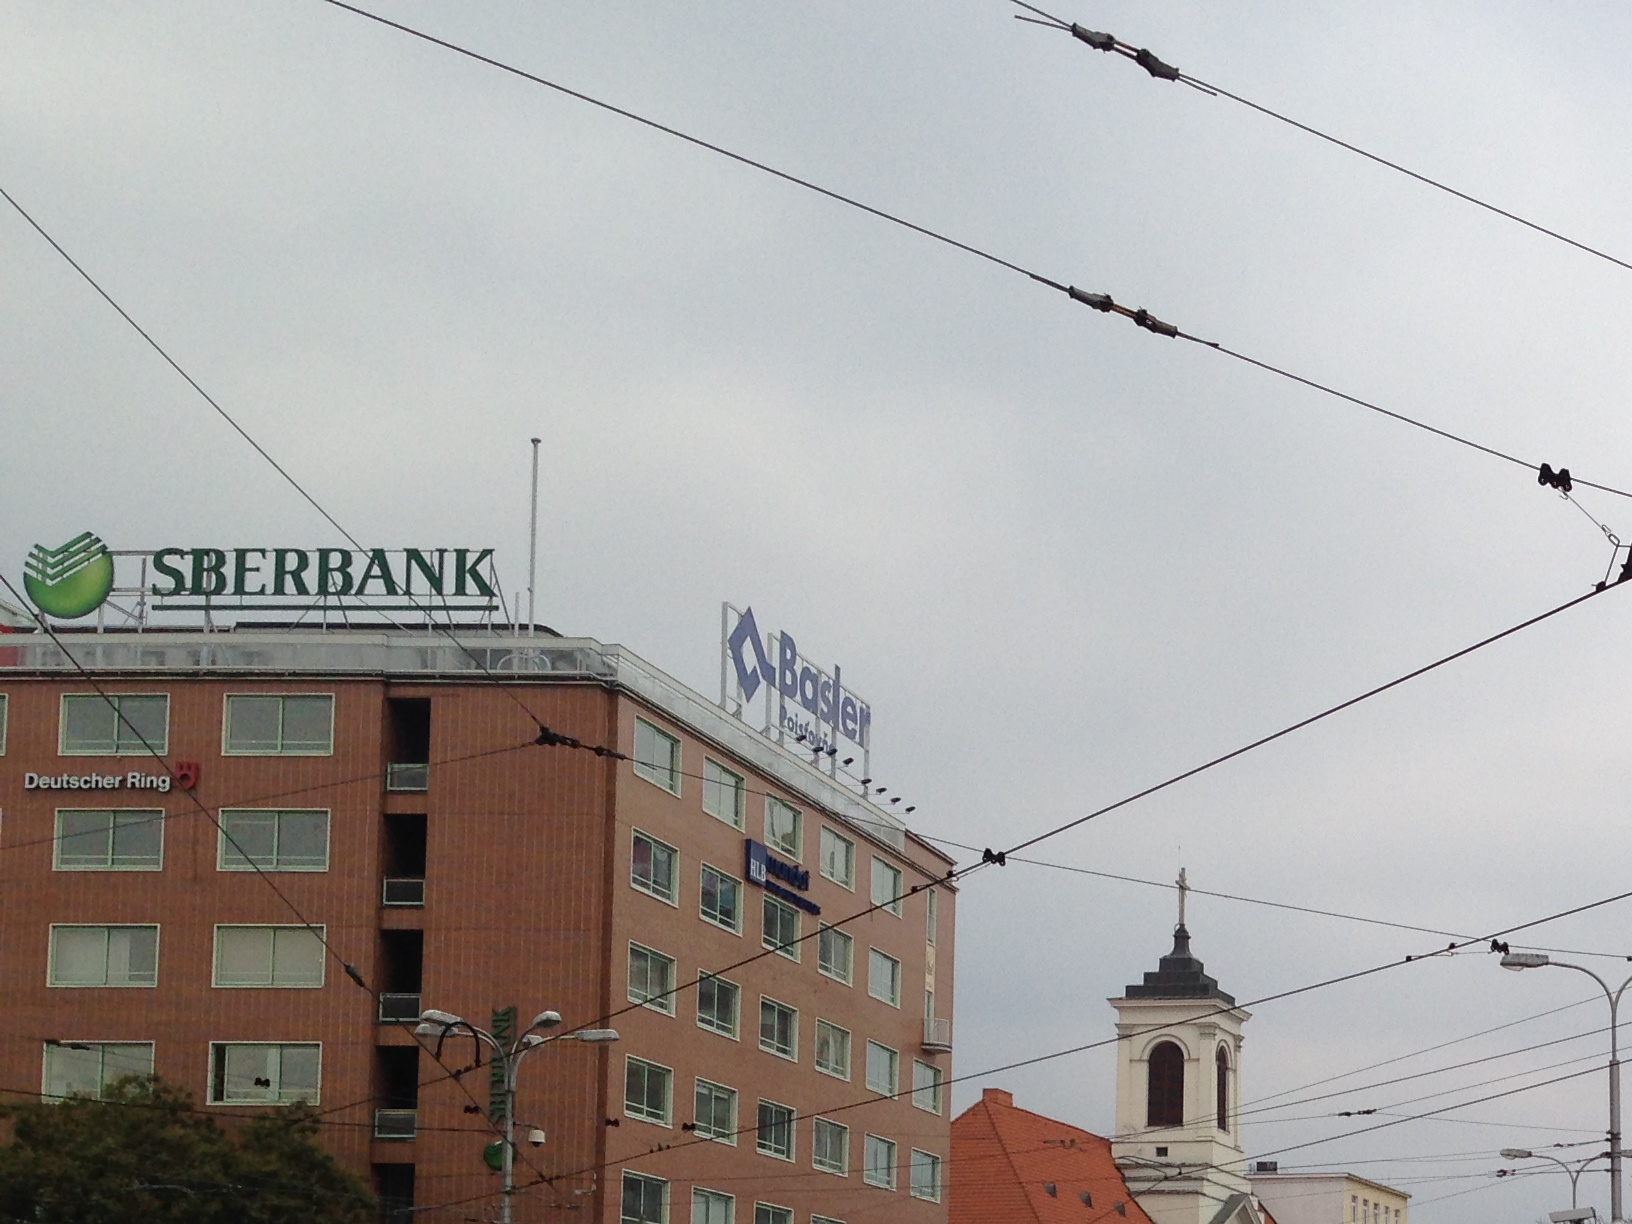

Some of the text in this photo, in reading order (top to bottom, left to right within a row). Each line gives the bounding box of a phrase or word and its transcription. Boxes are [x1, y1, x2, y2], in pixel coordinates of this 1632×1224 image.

[152, 547, 498, 598] SBERBANK
[779, 629, 871, 748] Basler
[24, 771, 170, 792] Deutscher Ring
[751, 858, 767, 881] HLB
